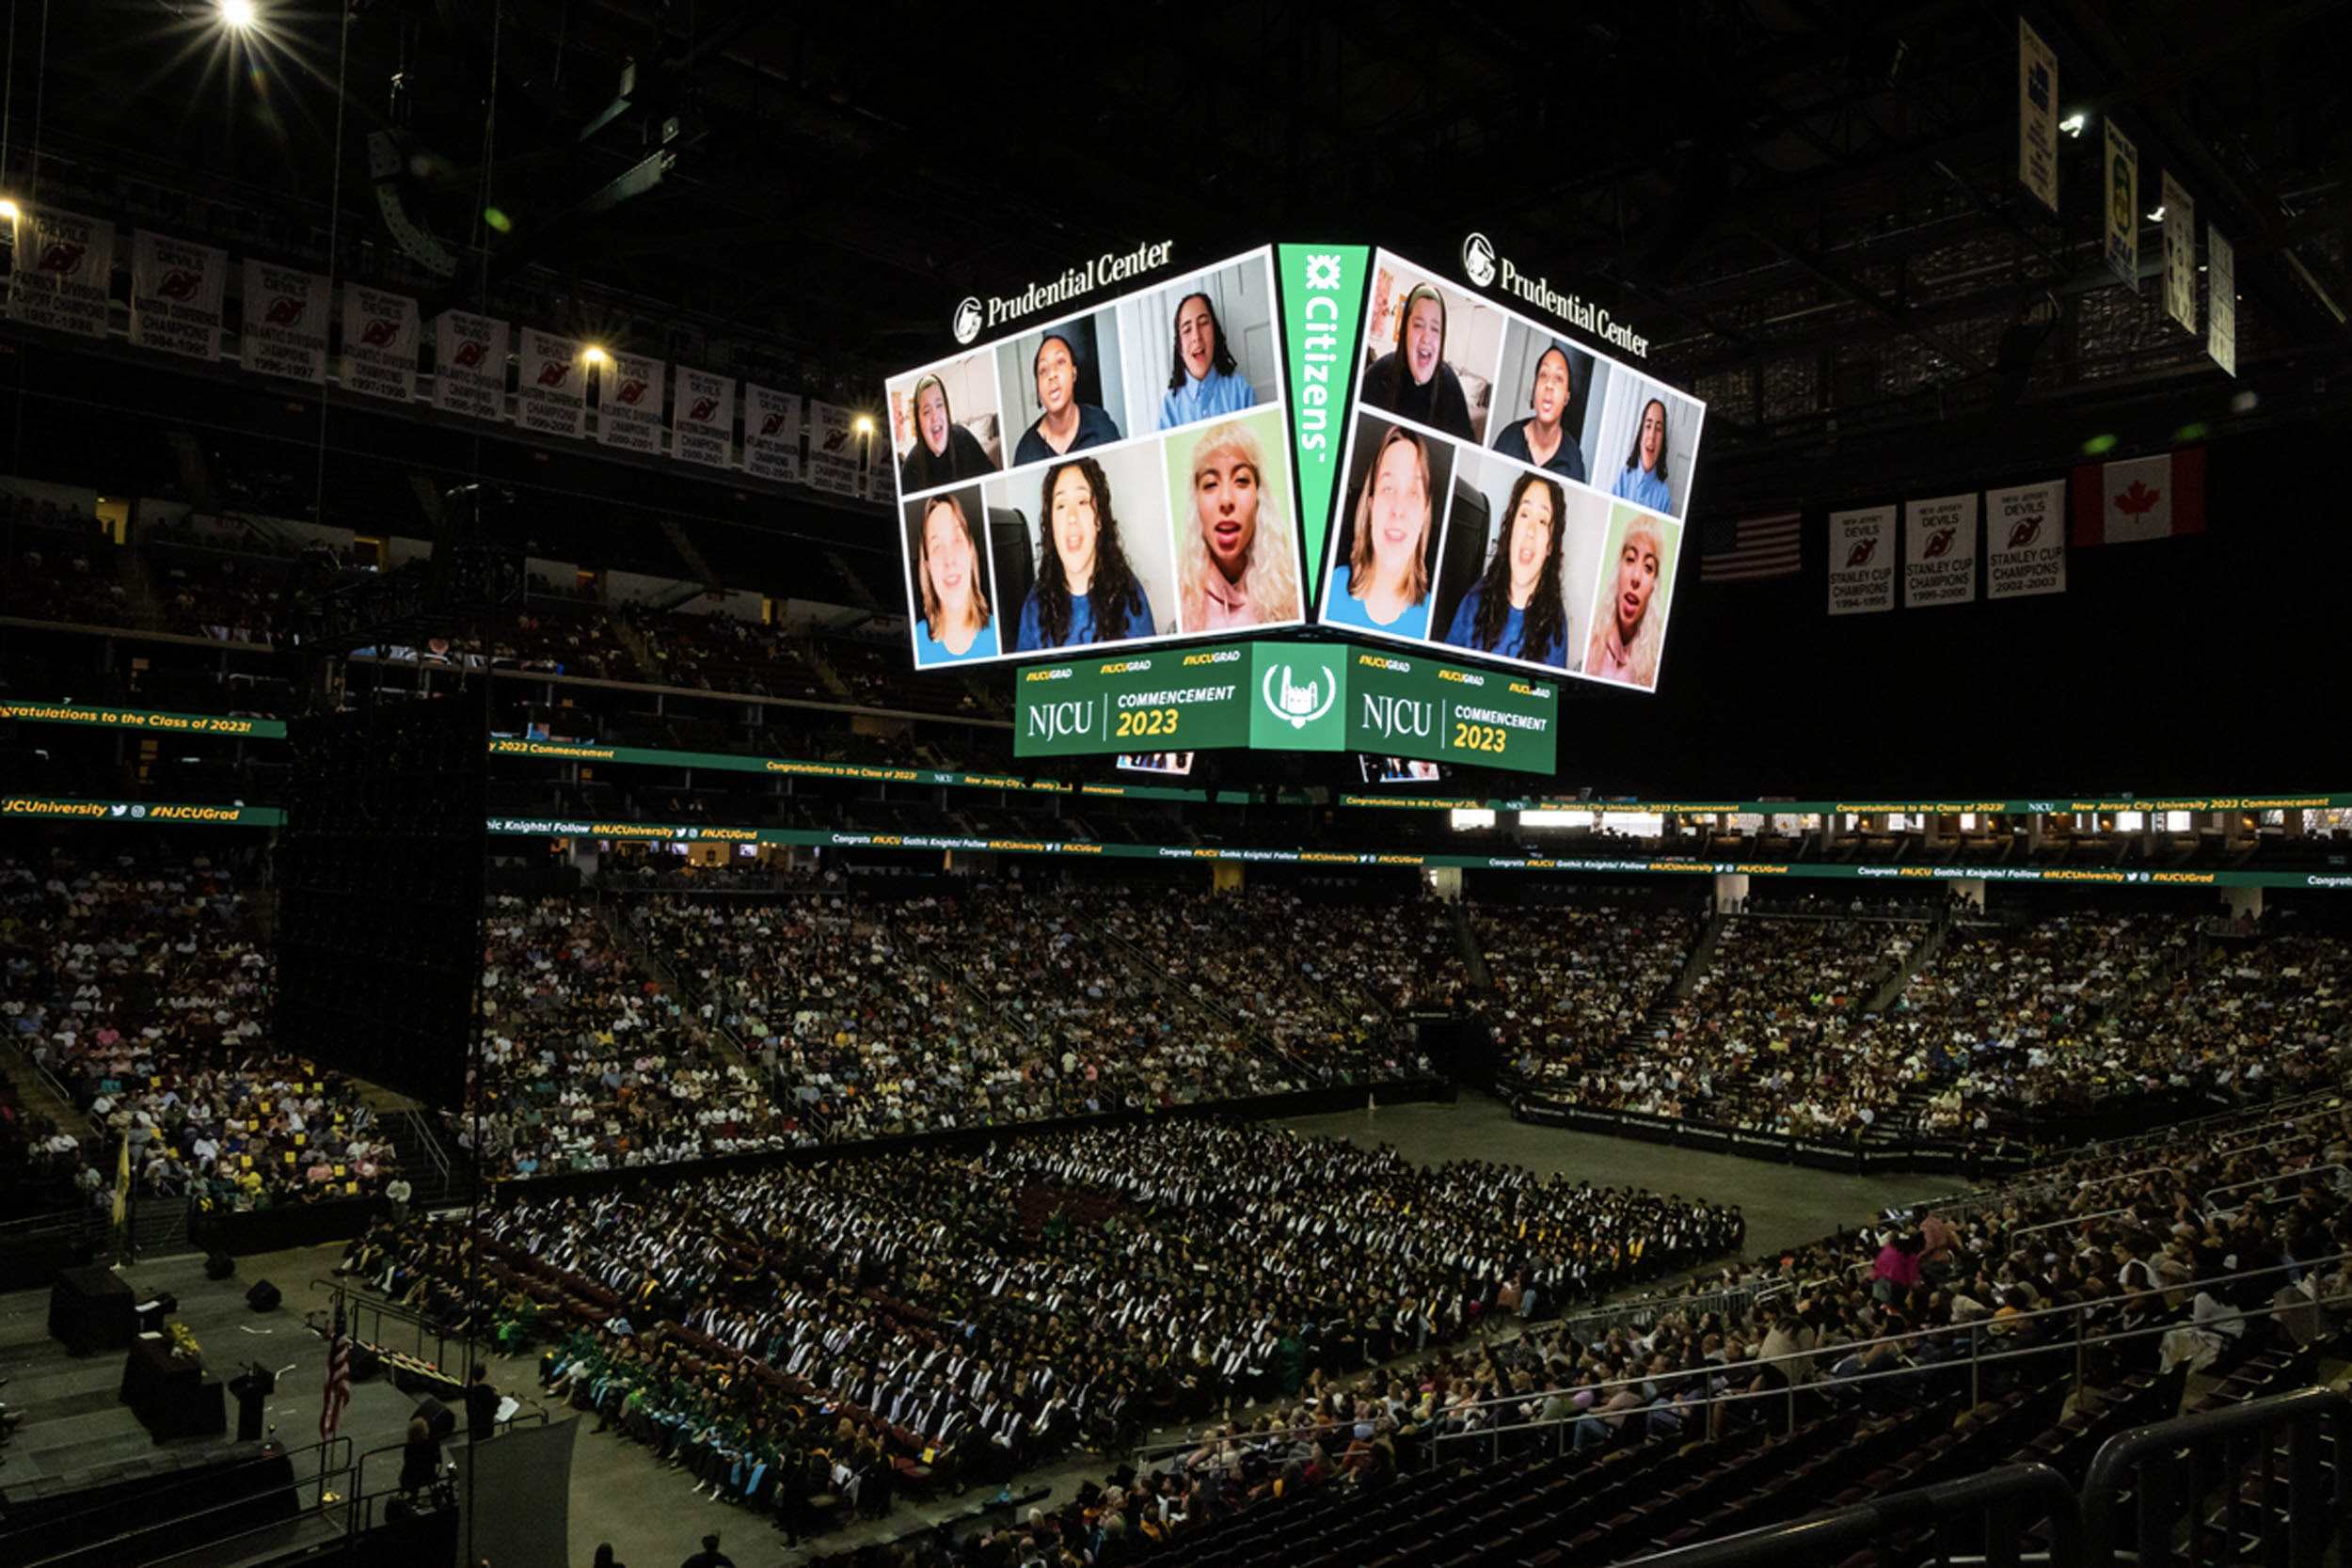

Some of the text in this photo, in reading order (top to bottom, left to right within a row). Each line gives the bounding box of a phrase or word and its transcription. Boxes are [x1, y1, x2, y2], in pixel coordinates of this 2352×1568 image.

[988, 239, 1172, 327] Prudential Center
[1500, 258, 1650, 359] Prudential Center
[143, 315, 210, 341] CHAMPIONS
[1302, 296, 1338, 450] Citizens
[2005, 500, 2045, 516] DEVILS
[1922, 514, 1959, 528] DEVILS
[1844, 525, 1879, 538] DEVILS
[1990, 546, 2062, 566] STANLEY CUP
[1830, 566, 1891, 584] STANLEY CUP
[1906, 558, 1973, 577] STANLEY CUP
[1993, 562, 2058, 580] CHAMPIONS
[1833, 581, 1888, 597] CHAMPIONS
[1909, 572, 1969, 590] CHAMPIONS
[1100, 660, 1152, 674] #NJCUGRAD
[1183, 651, 1241, 666] #NJCUGRAD
[1359, 654, 1410, 673] #NJCUGRAD
[1438, 669, 1484, 687] #NJCUGRAD
[1118, 685, 1235, 708] COMMENCEMENT
[102, 713, 117, 721] to
[120, 715, 145, 724] the
[149, 715, 188, 727] Class
[191, 720, 208, 728] of
[209, 721, 252, 732] 2023!
[1027, 700, 1094, 742] NJCU
[1116, 708, 1179, 736] 2023
[1361, 693, 1432, 738] NJCU
[1454, 705, 1548, 731] COMMENCEMENT
[1454, 722, 1506, 753] 2023
[499, 741, 528, 752] 2023
[529, 744, 613, 757] Commencement
[766, 762, 834, 773] Congratulations
[861, 768, 882, 777] Class
[0, 800, 240, 819] JCUniversity #NJCUGrad
[1432, 800, 1454, 808] Class
[1607, 803, 1648, 812] University
[1673, 804, 1740, 813] Commencement
[1836, 802, 1906, 813] Congratulations
[1936, 803, 1962, 813] Class
[1963, 803, 1976, 813] of
[2028, 802, 2055, 812] NJCU
[2072, 798, 2329, 812] New Jersey City University 2023 Commencement
[504, 821, 552, 832] Knights!
[553, 823, 590, 832] Follow
[591, 825, 675, 837] @NJCUniversity
[700, 830, 758, 839] #NJCUGrad
[832, 834, 871, 845] Congrats
[1857, 867, 1899, 876] Congrats
[2153, 873, 2215, 882] #NJCUGrad
